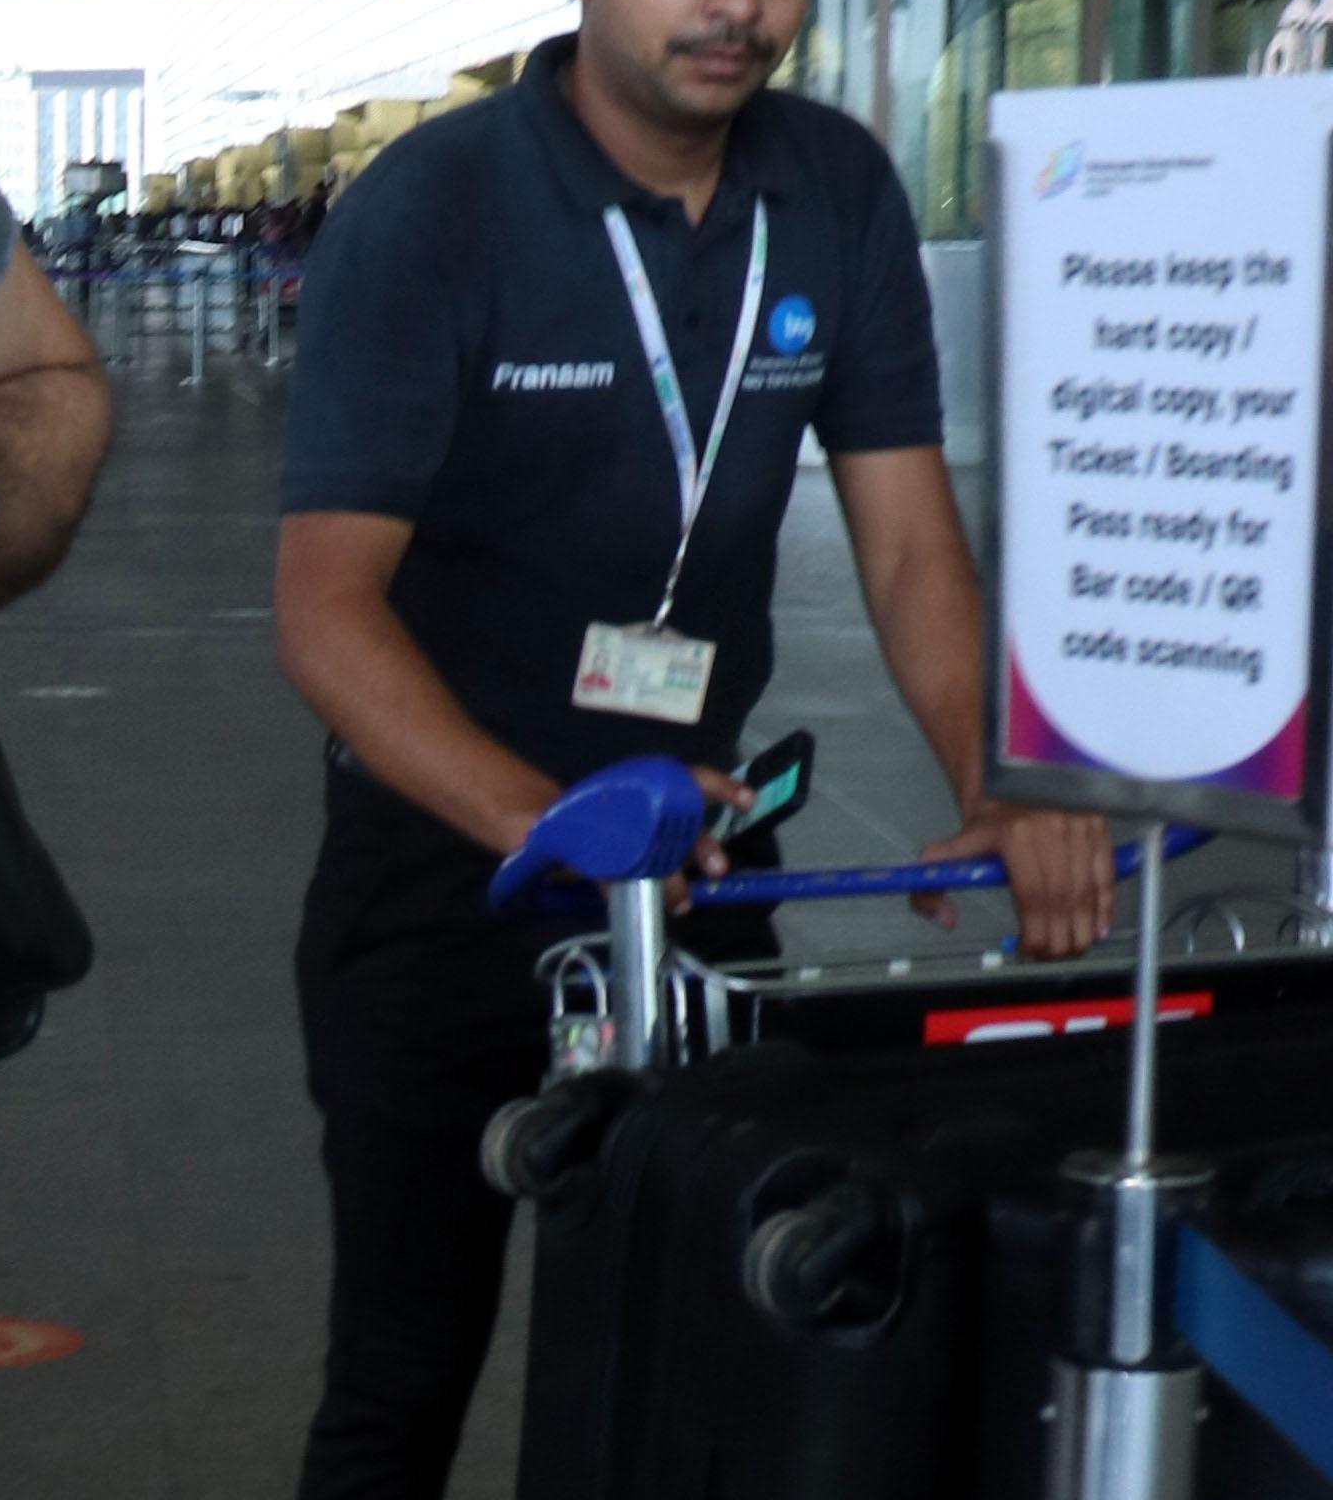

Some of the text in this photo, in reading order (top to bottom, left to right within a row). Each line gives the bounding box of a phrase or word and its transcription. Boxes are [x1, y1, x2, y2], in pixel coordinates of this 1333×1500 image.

[1061, 250, 1291, 294] Please keep the
[1093, 314, 1259, 361] hard copy /
[1050, 376, 1144, 422] digital
[1231, 387, 1298, 425] your
[1047, 438, 1294, 493] Ticket / Boarding
[1067, 501, 1271, 553] Pass ready for
[1070, 563, 1262, 612] Bar code / QR
[1061, 628, 1264, 686] code scanning
